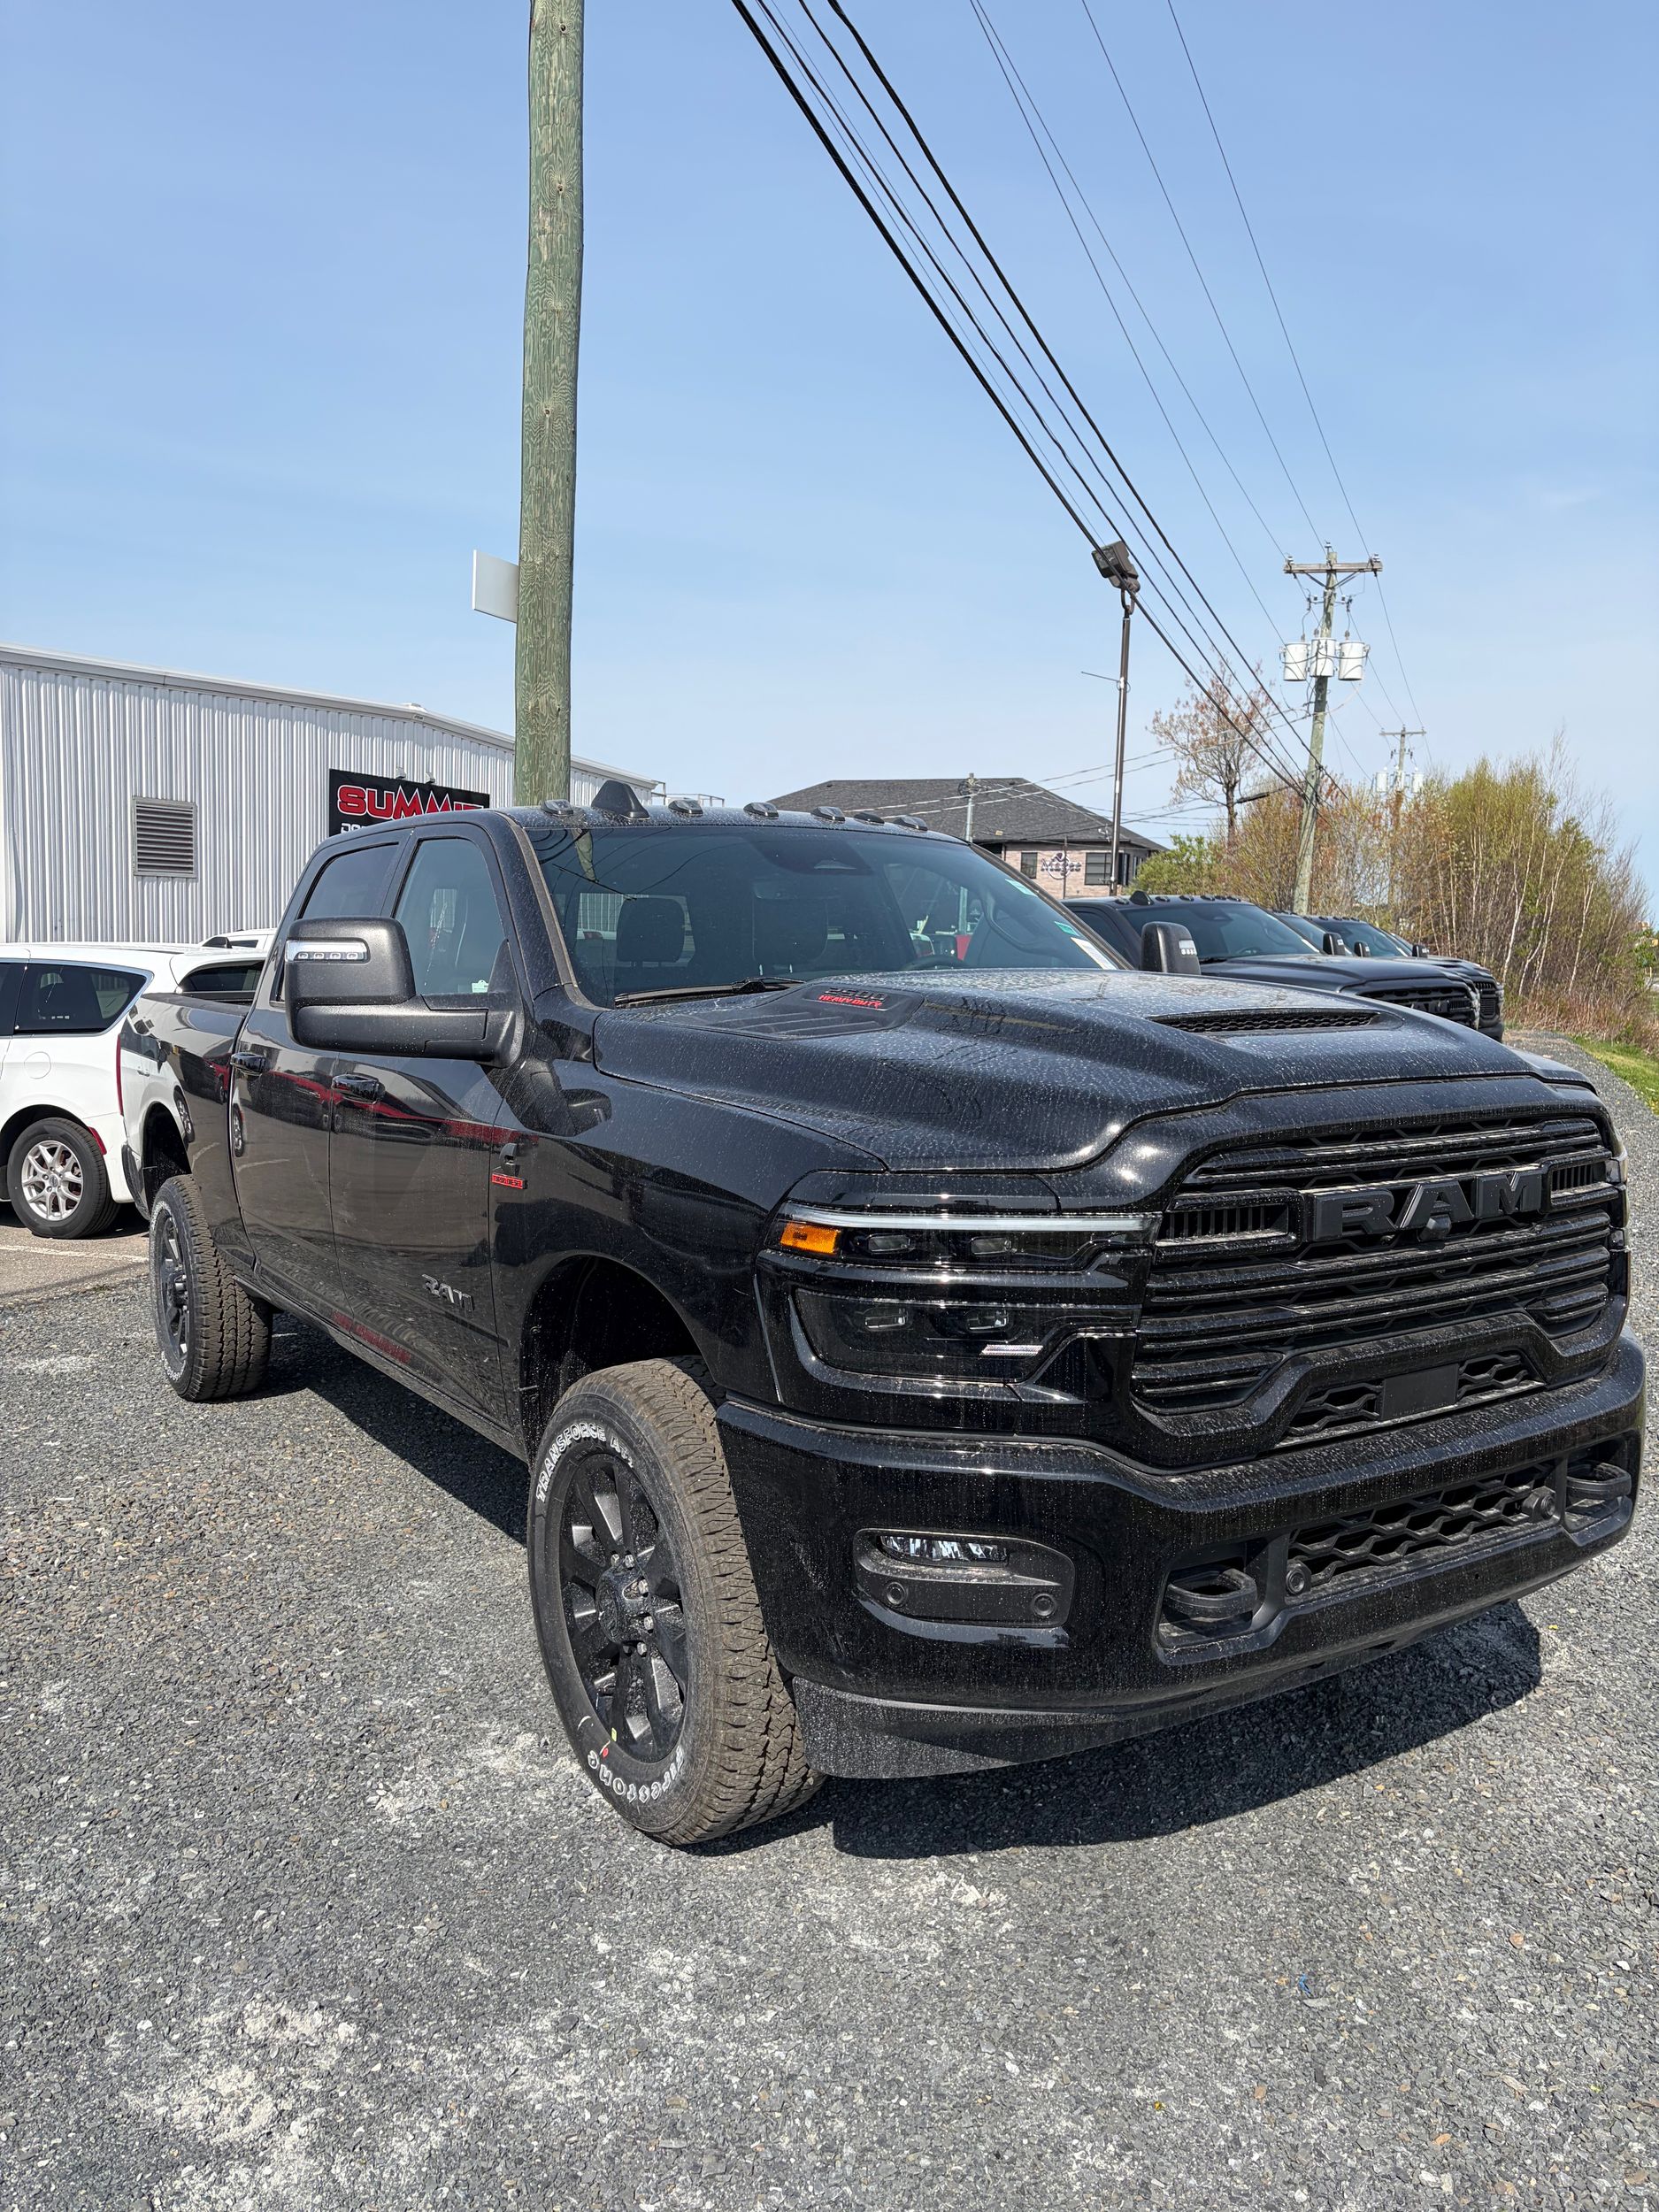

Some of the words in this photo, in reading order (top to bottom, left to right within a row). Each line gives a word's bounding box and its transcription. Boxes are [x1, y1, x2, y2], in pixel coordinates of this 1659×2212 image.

[338, 785, 484, 820] SUMM
[818, 995, 852, 1004] HEAVY
[851, 998, 883, 1009] DUTY
[824, 987, 888, 1002] 2500
[1313, 1171, 1543, 1242] RAM
[422, 1274, 474, 1314] RAM
[535, 1422, 607, 1503] TRANSFORCE
